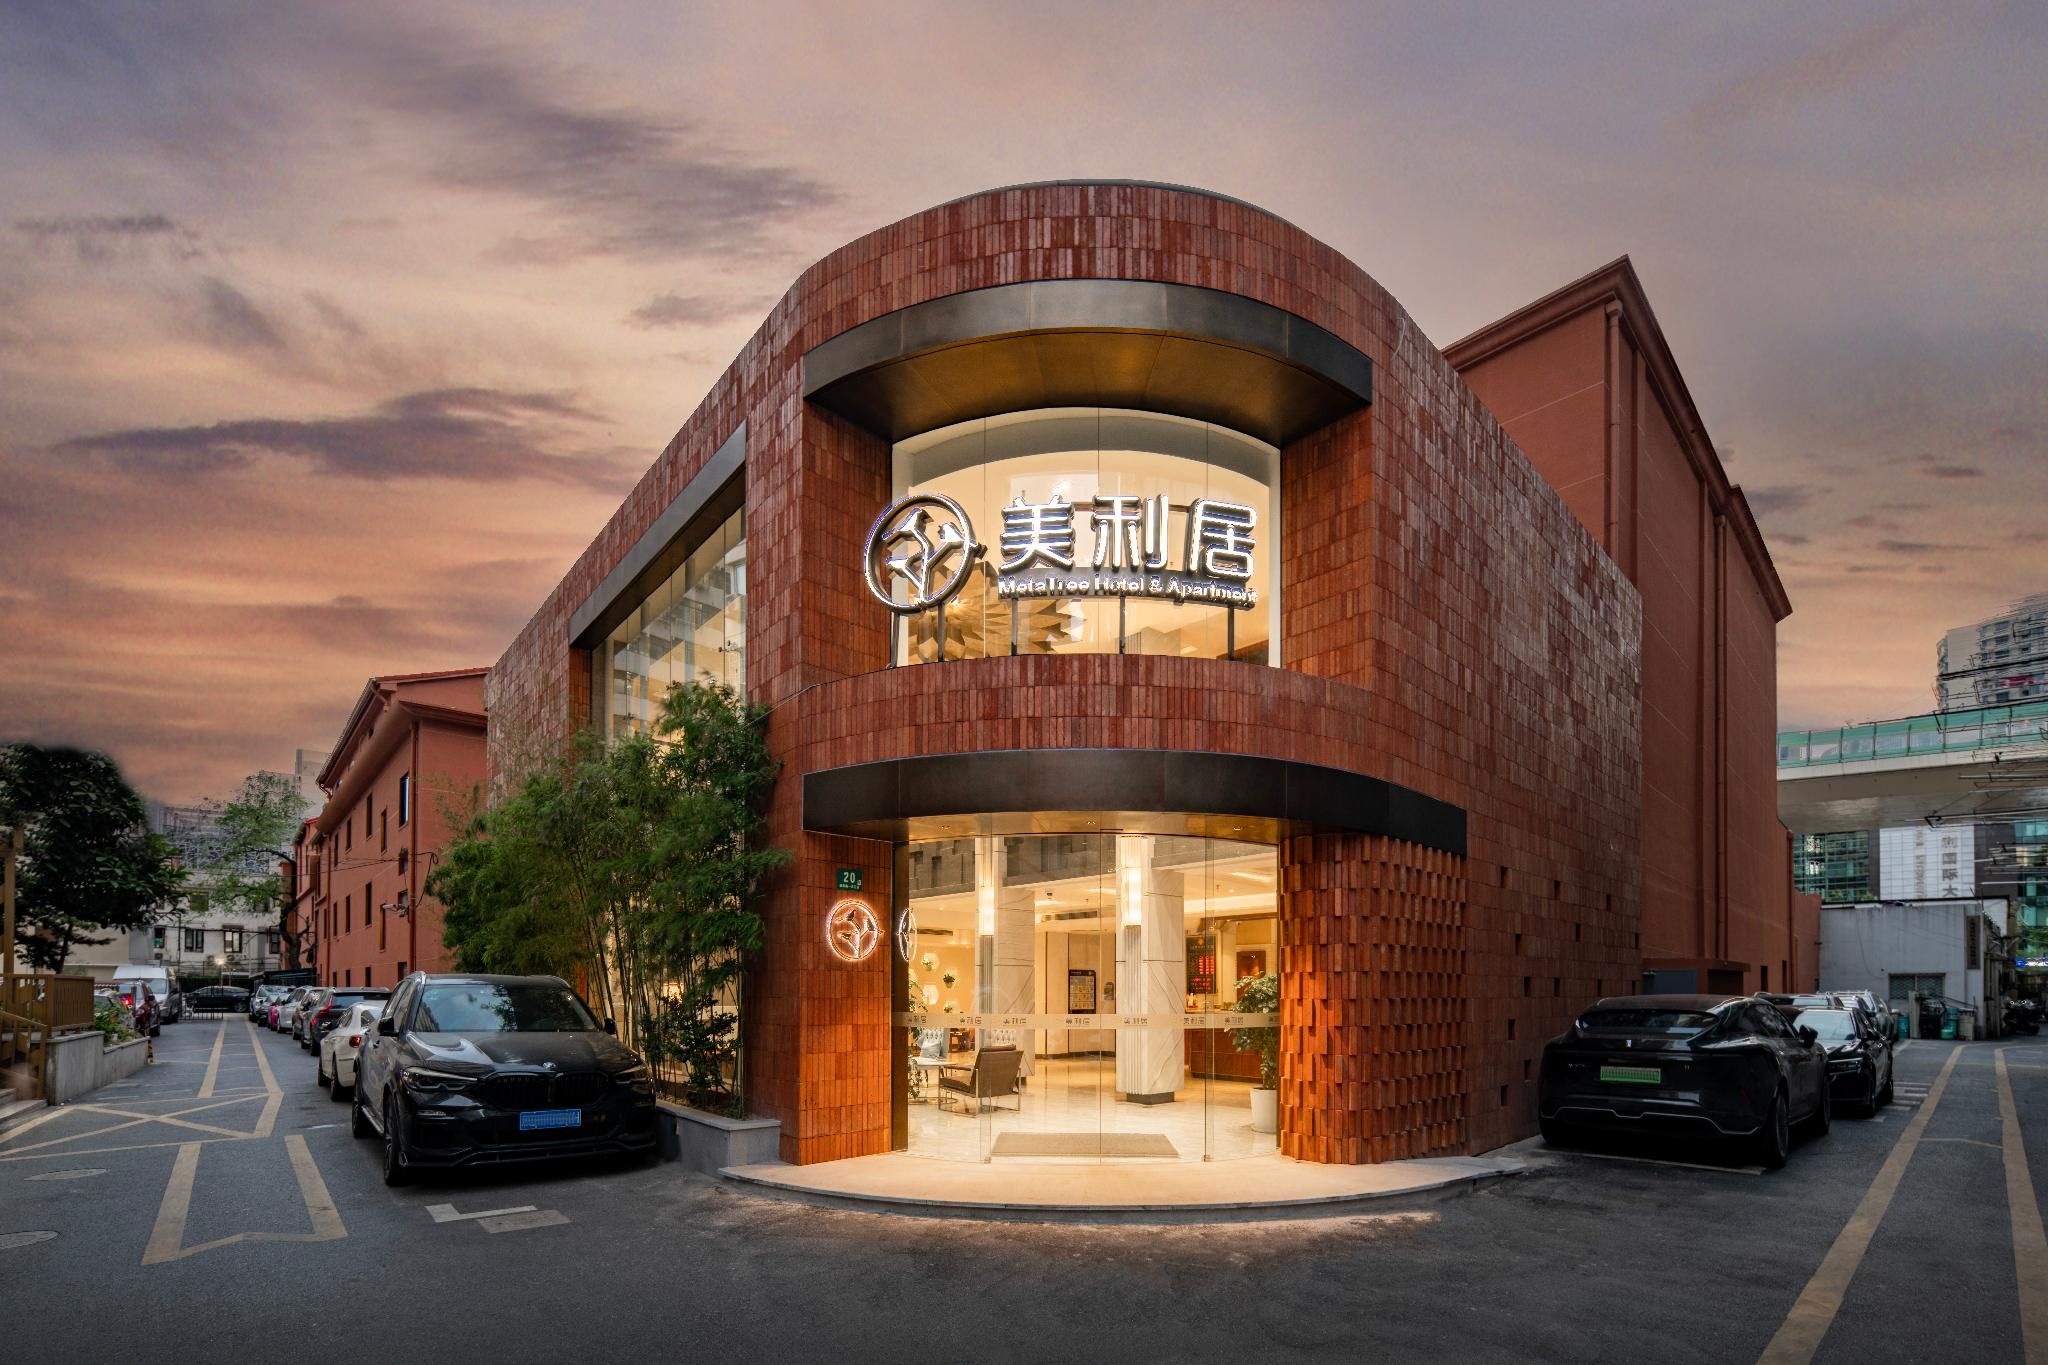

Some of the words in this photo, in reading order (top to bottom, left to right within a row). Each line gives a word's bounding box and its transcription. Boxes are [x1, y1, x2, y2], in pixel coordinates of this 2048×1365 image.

[1000, 494, 1257, 577] 美利居
[1094, 574, 1145, 592] Hotel
[1148, 575, 1164, 593] &
[843, 871, 855, 883] 20
